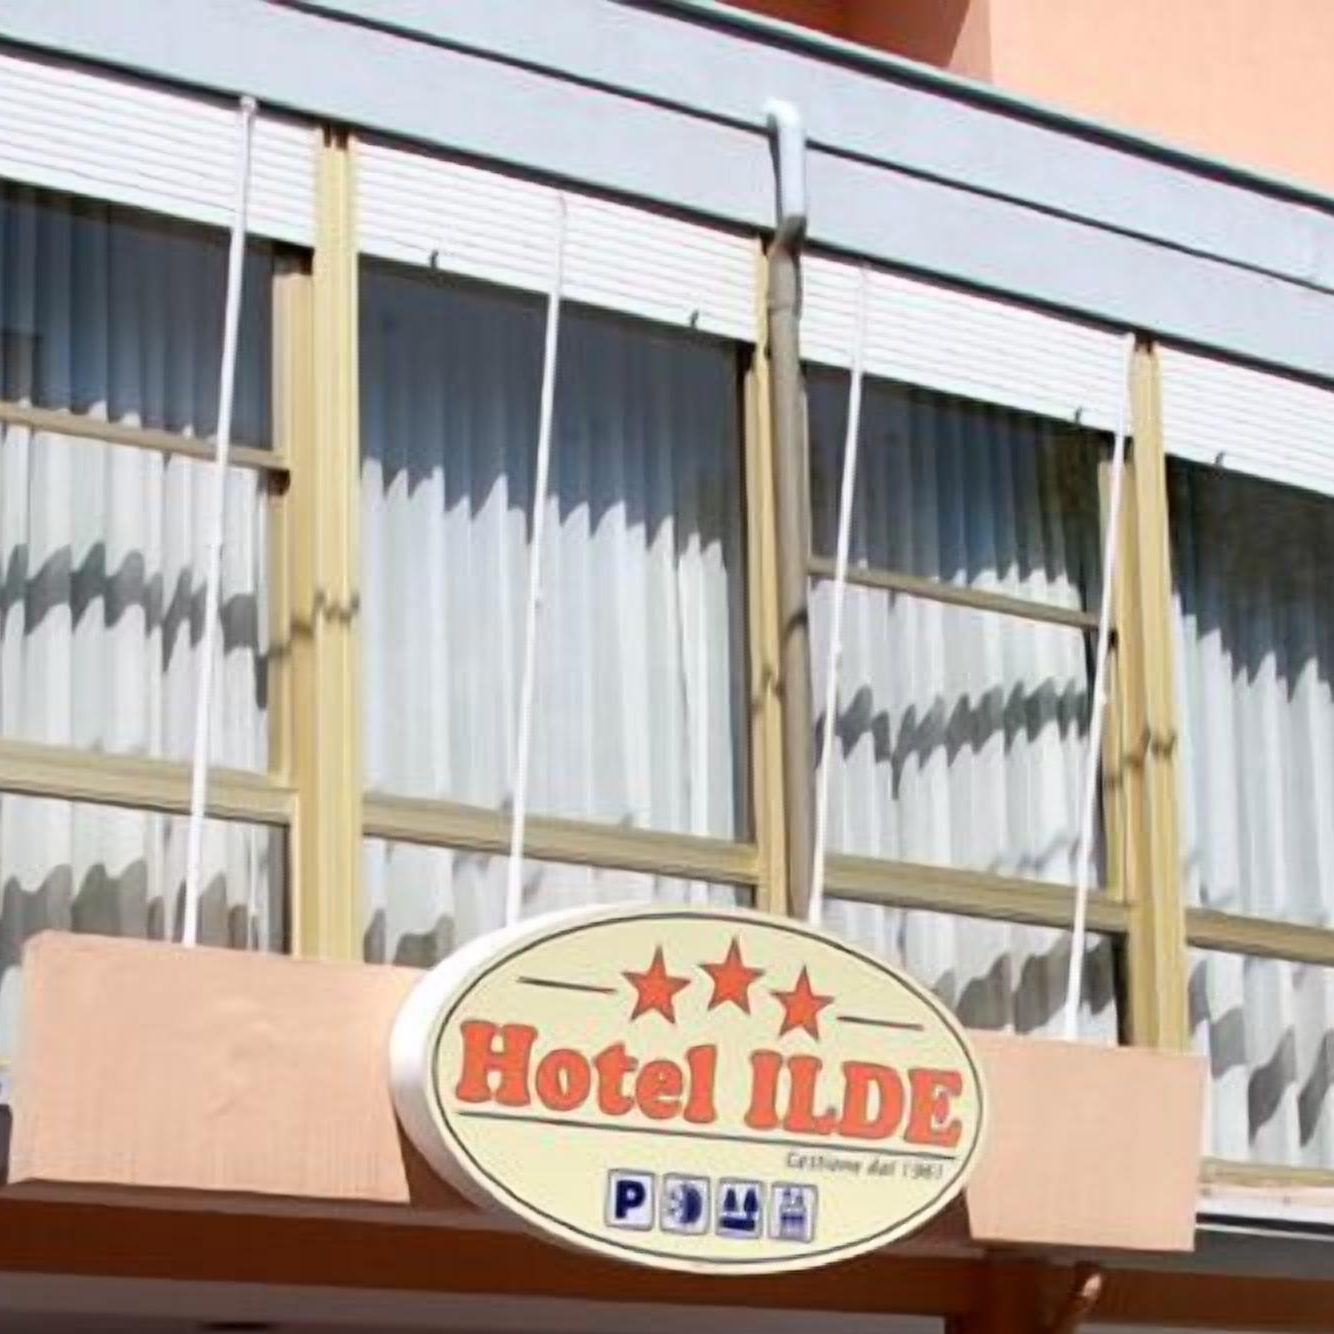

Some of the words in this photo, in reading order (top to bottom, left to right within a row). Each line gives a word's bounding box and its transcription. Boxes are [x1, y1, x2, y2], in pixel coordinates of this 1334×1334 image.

[454, 1018, 718, 1126] Hotel
[744, 1048, 964, 1149] ILDE
[614, 1179, 646, 1220] P
